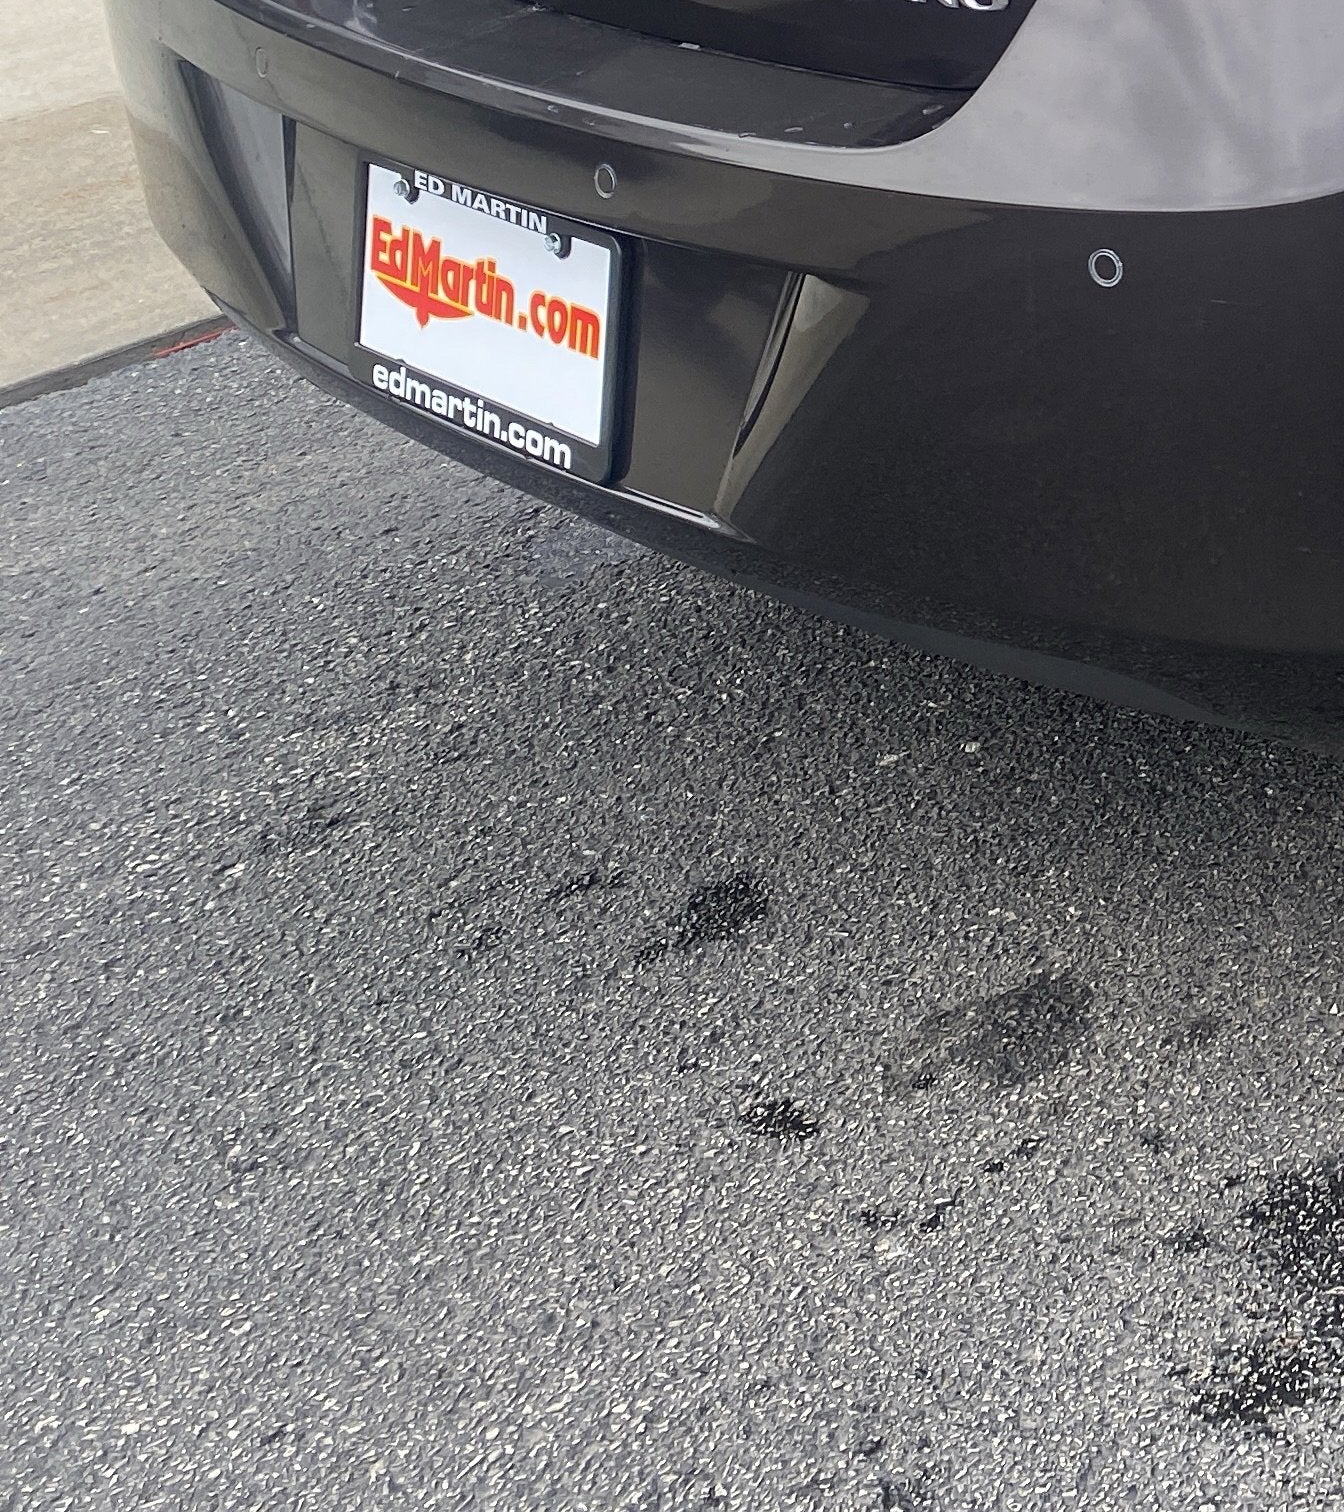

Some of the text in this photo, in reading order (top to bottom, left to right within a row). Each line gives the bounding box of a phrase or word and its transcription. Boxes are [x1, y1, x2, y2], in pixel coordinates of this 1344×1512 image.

[414, 170, 548, 233] ED MARTIN
[371, 215, 600, 359] EdMartin.com
[372, 364, 571, 469] edmartin.com
